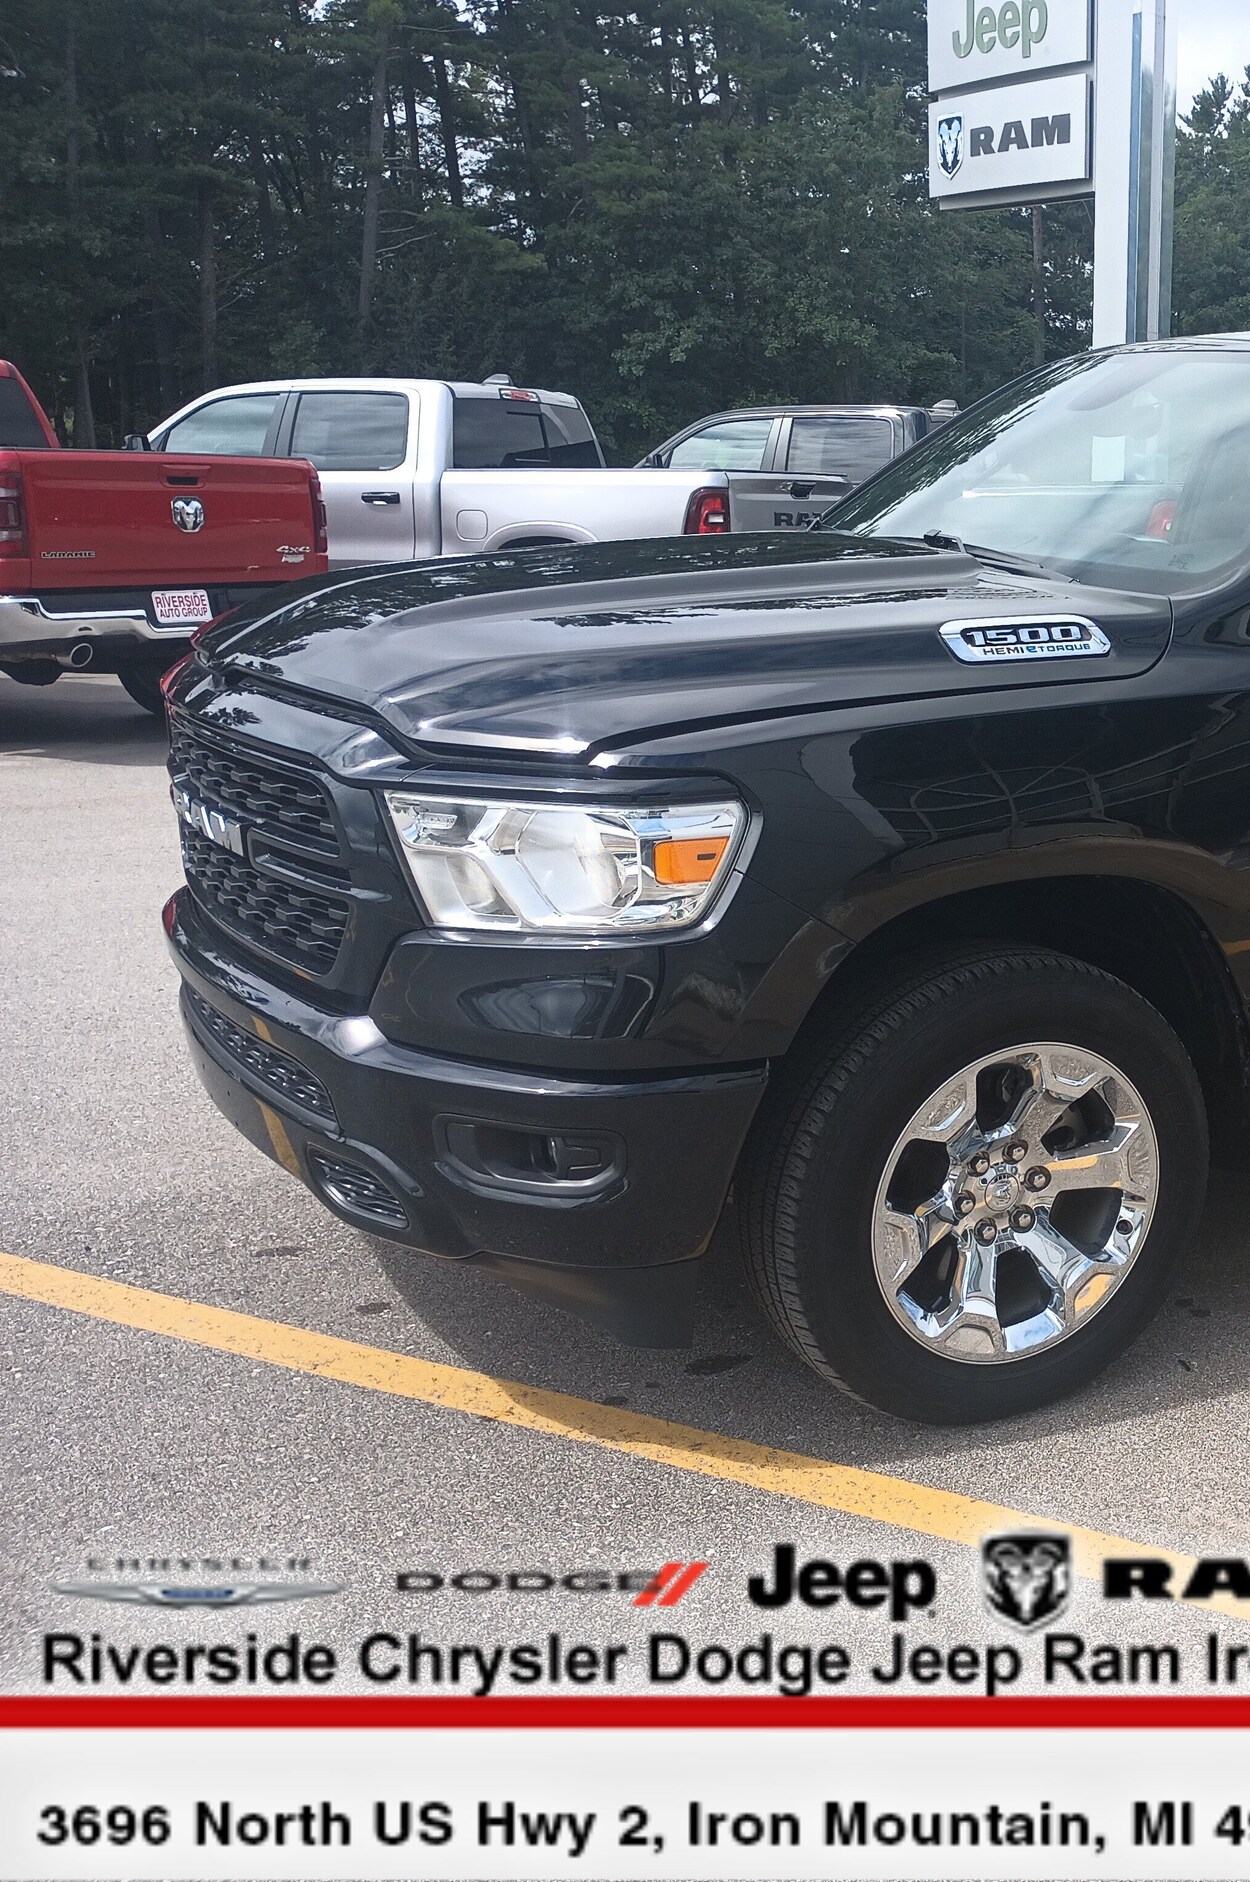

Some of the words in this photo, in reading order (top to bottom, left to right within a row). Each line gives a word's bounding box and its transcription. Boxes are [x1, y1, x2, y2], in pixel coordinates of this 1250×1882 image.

[952, 0, 1048, 58] Jeep
[970, 113, 1071, 157] RAM
[41, 551, 96, 559] LARAMIE
[155, 594, 207, 608] RIVERSIDE
[160, 608, 181, 618] AUTO
[181, 607, 208, 617] GROUP
[966, 625, 1082, 646] 1500
[983, 645, 1025, 655] HEMI
